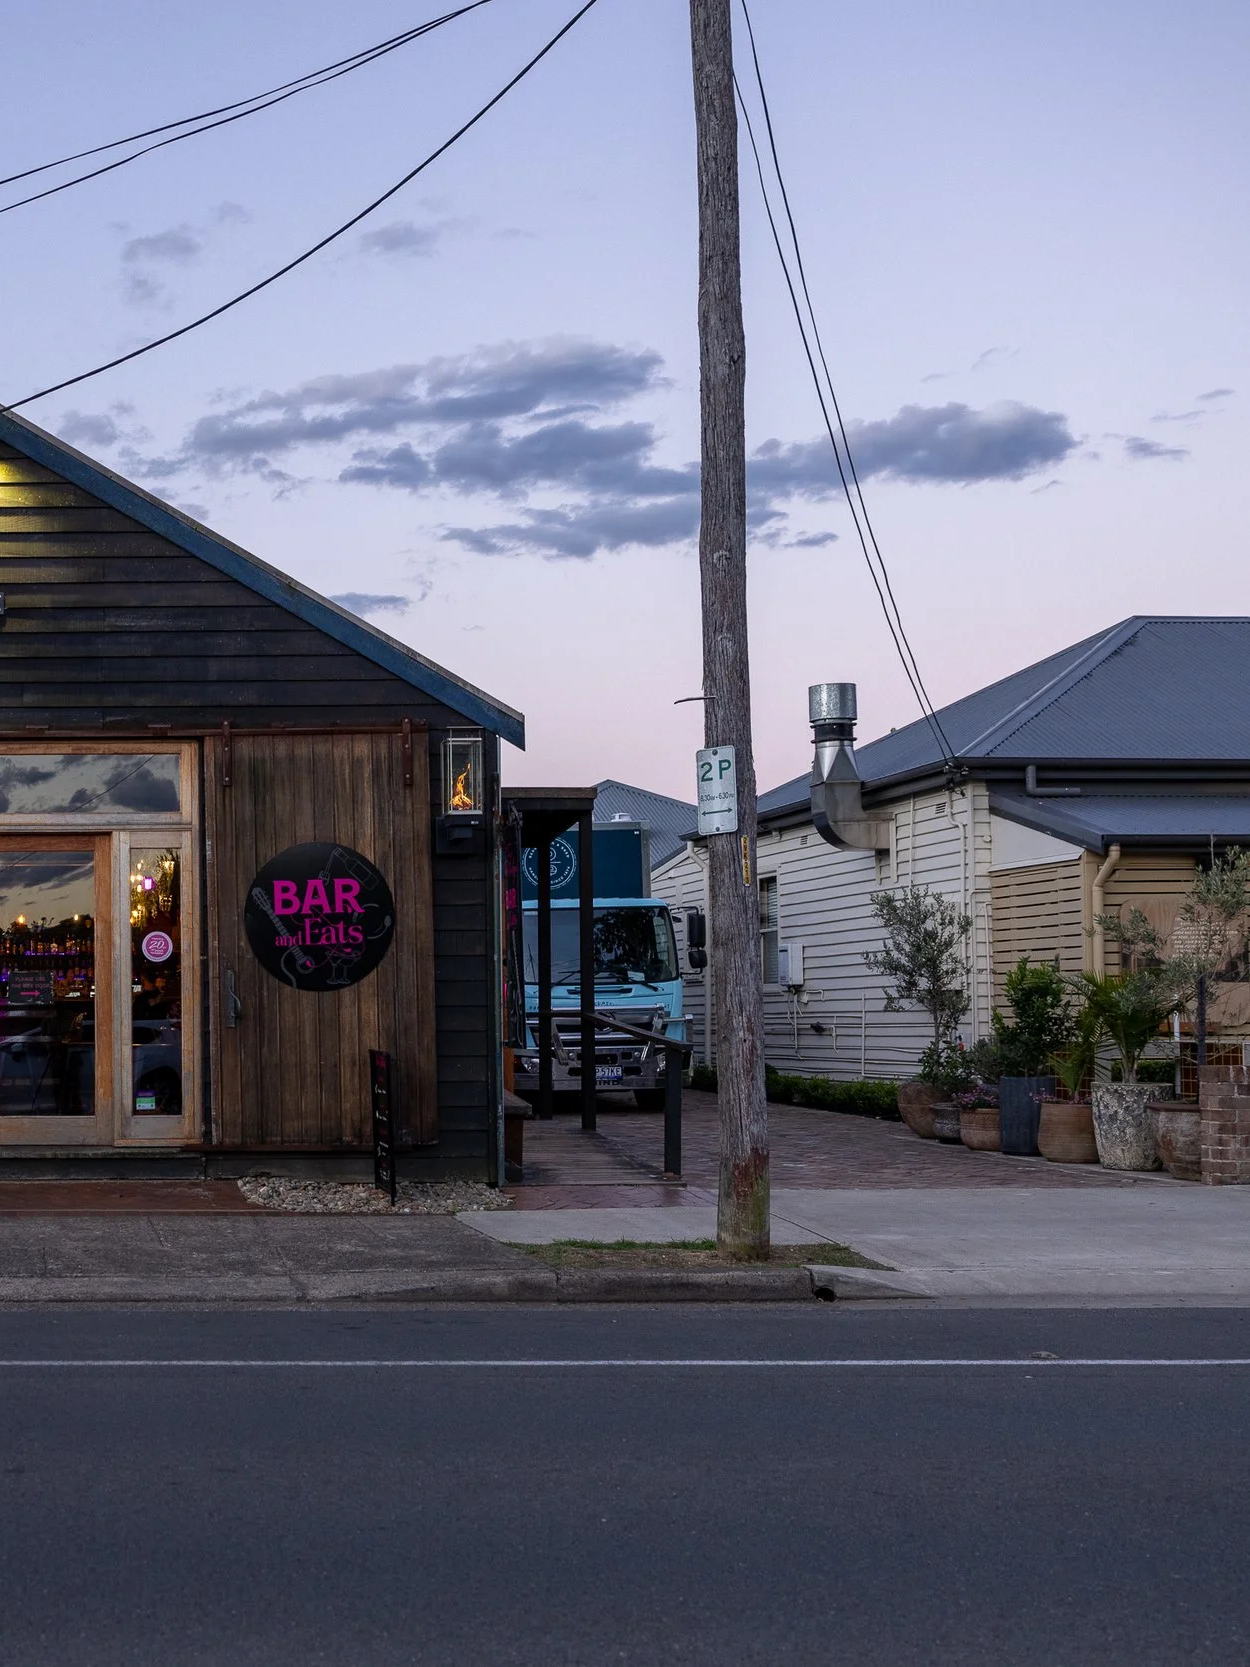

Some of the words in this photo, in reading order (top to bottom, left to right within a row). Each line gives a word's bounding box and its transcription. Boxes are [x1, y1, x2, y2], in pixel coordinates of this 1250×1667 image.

[700, 758, 732, 783] 2P
[273, 878, 366, 915] BAR
[275, 930, 302, 947] and
[304, 917, 364, 946] Eats
